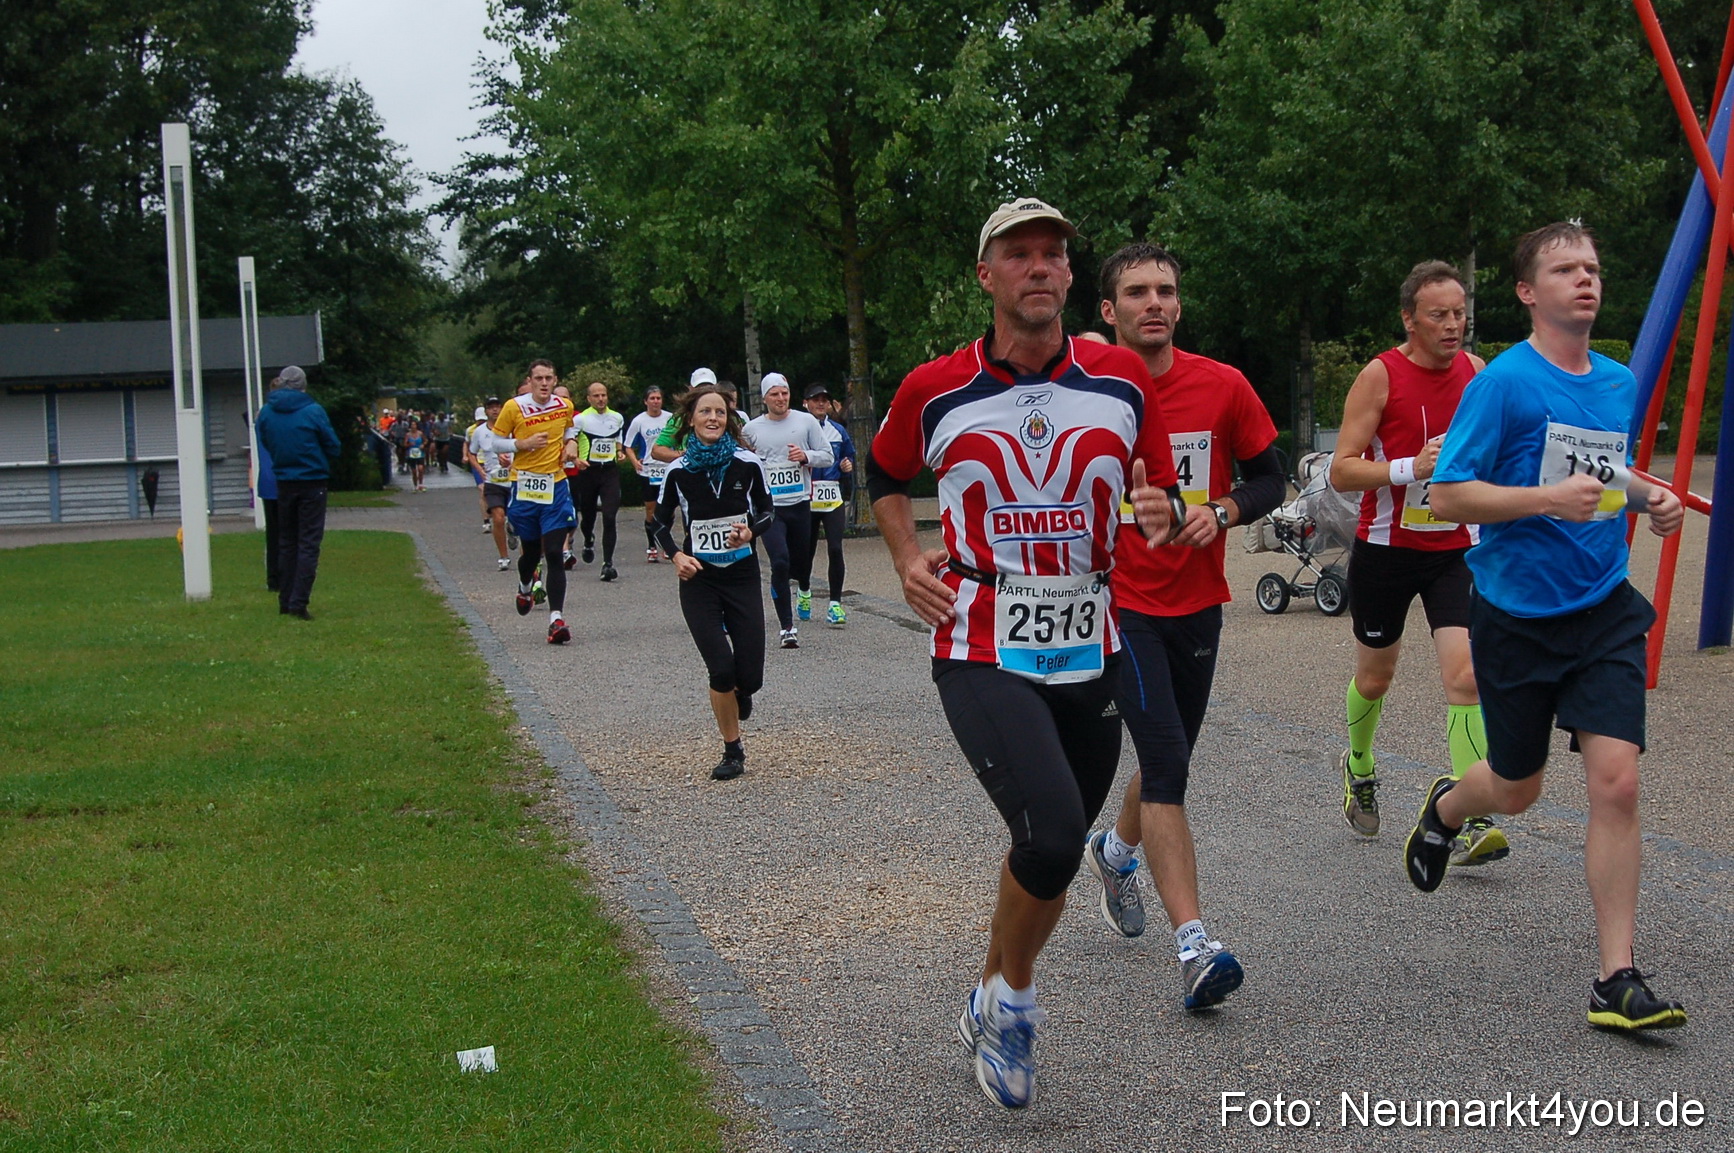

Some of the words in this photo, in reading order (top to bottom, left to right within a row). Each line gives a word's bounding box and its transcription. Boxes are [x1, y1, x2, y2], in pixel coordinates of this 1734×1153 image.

[1549, 432, 1578, 447] PARTL
[595, 443, 611, 453] 495
[1565, 450, 1615, 485] 116
[524, 478, 547, 491] 486
[770, 469, 801, 486] 2036
[817, 488, 837, 500] 206
[992, 509, 1087, 535] BIMBO
[709, 553, 738, 563] GISELA
[999, 585, 1040, 598] PARTL
[1042, 585, 1089, 598] Neumarkt
[1008, 600, 1096, 644] 2513
[1036, 654, 1071, 670] Peter
